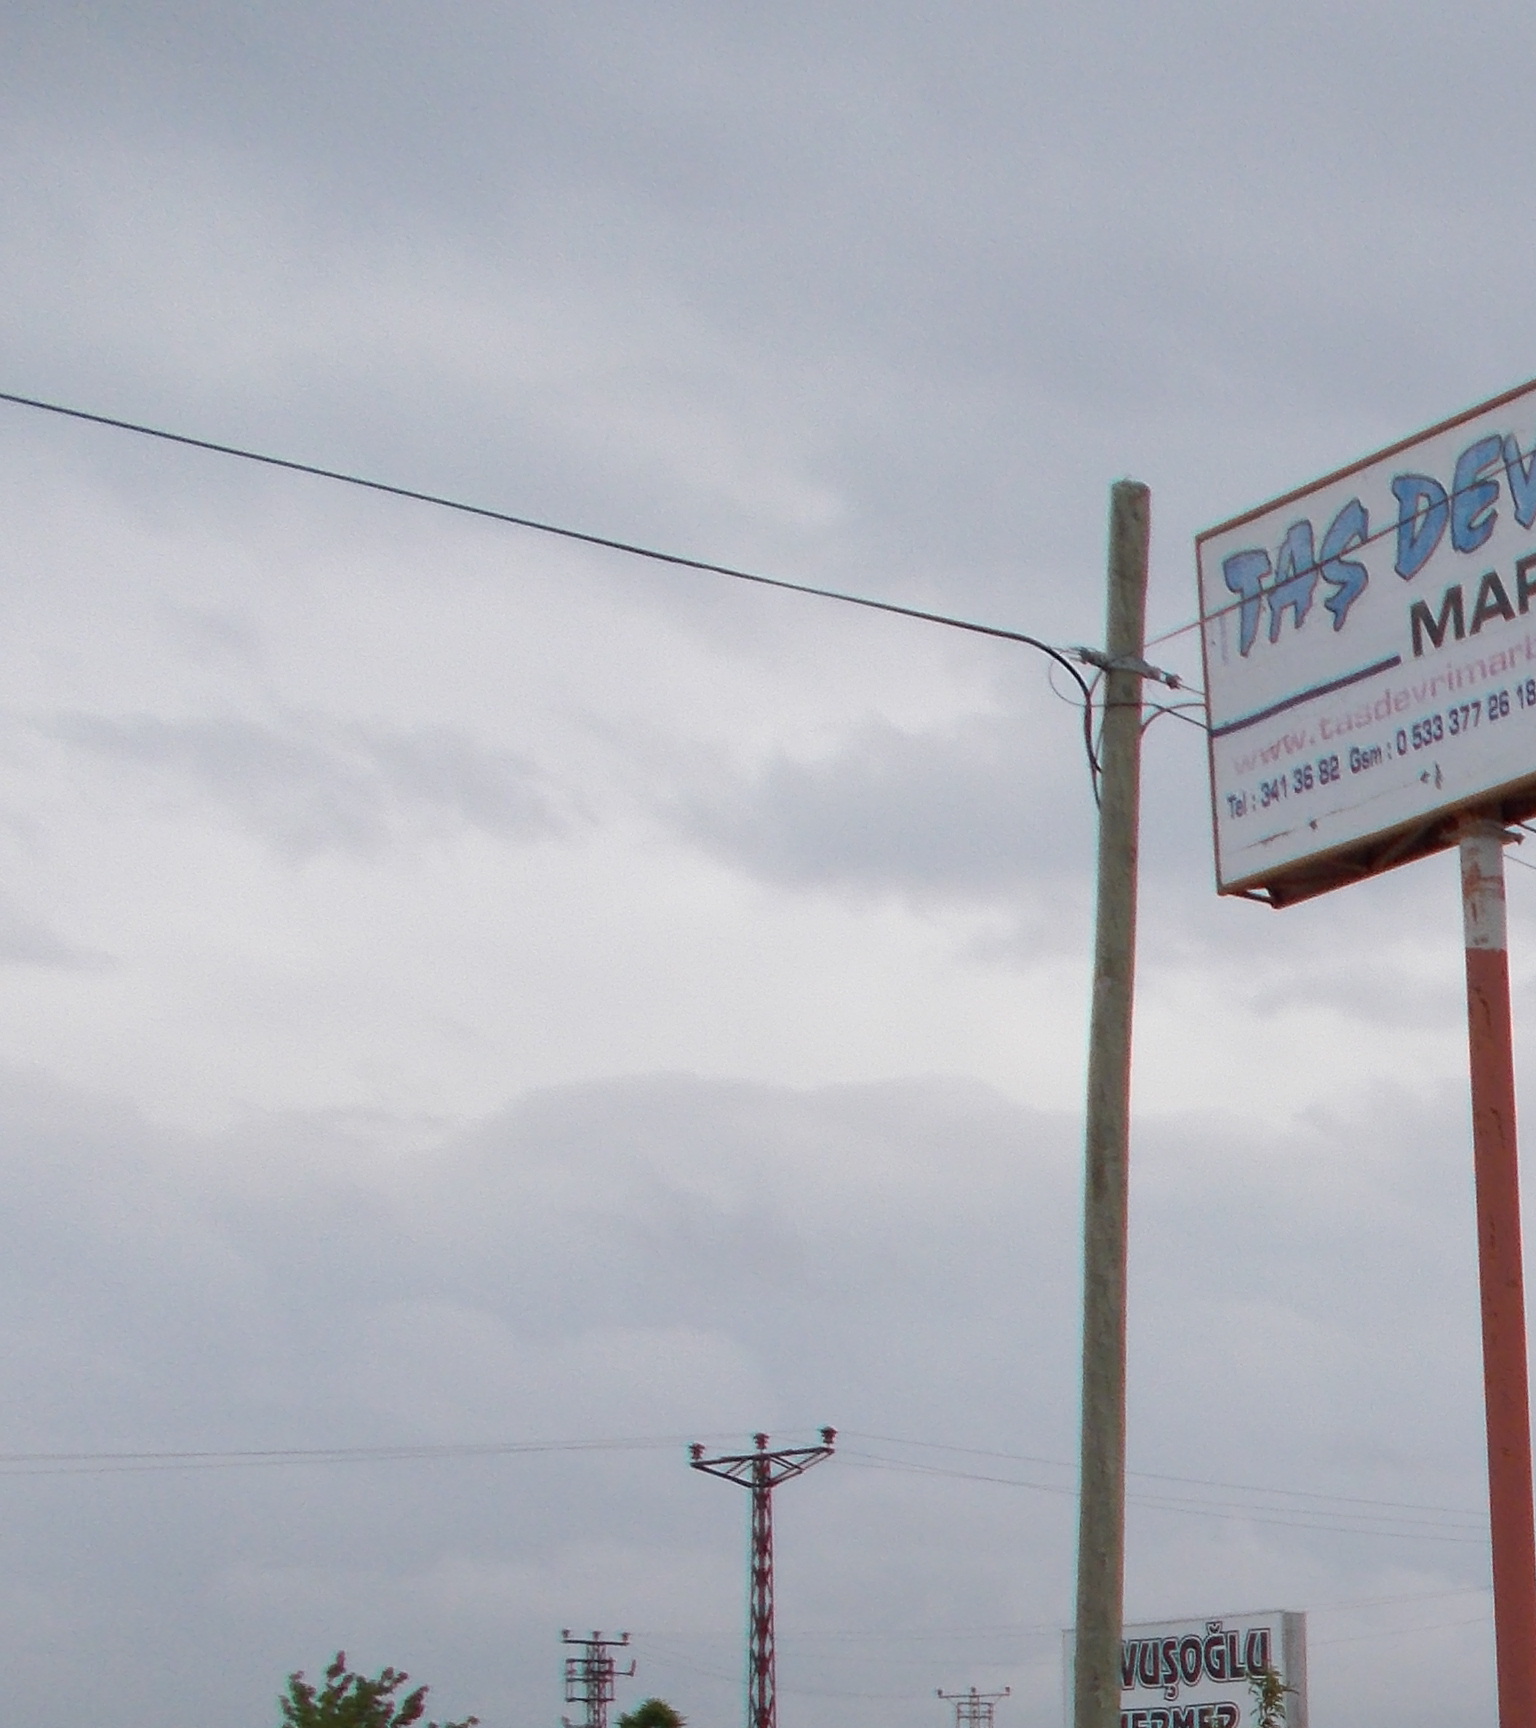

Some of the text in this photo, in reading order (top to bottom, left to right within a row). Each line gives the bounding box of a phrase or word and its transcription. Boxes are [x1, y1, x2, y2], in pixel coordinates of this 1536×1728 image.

[1260, 774, 1288, 808] 341
[1293, 763, 1314, 795] 36
[1318, 754, 1340, 786] 82
[1349, 744, 1383, 774] Gsm
[1396, 729, 1407, 757] 0
[1412, 714, 1444, 750] 533
[1448, 700, 1482, 738] 377
[1488, 690, 1510, 722] 26
[1516, 678, 1536, 710] 18
